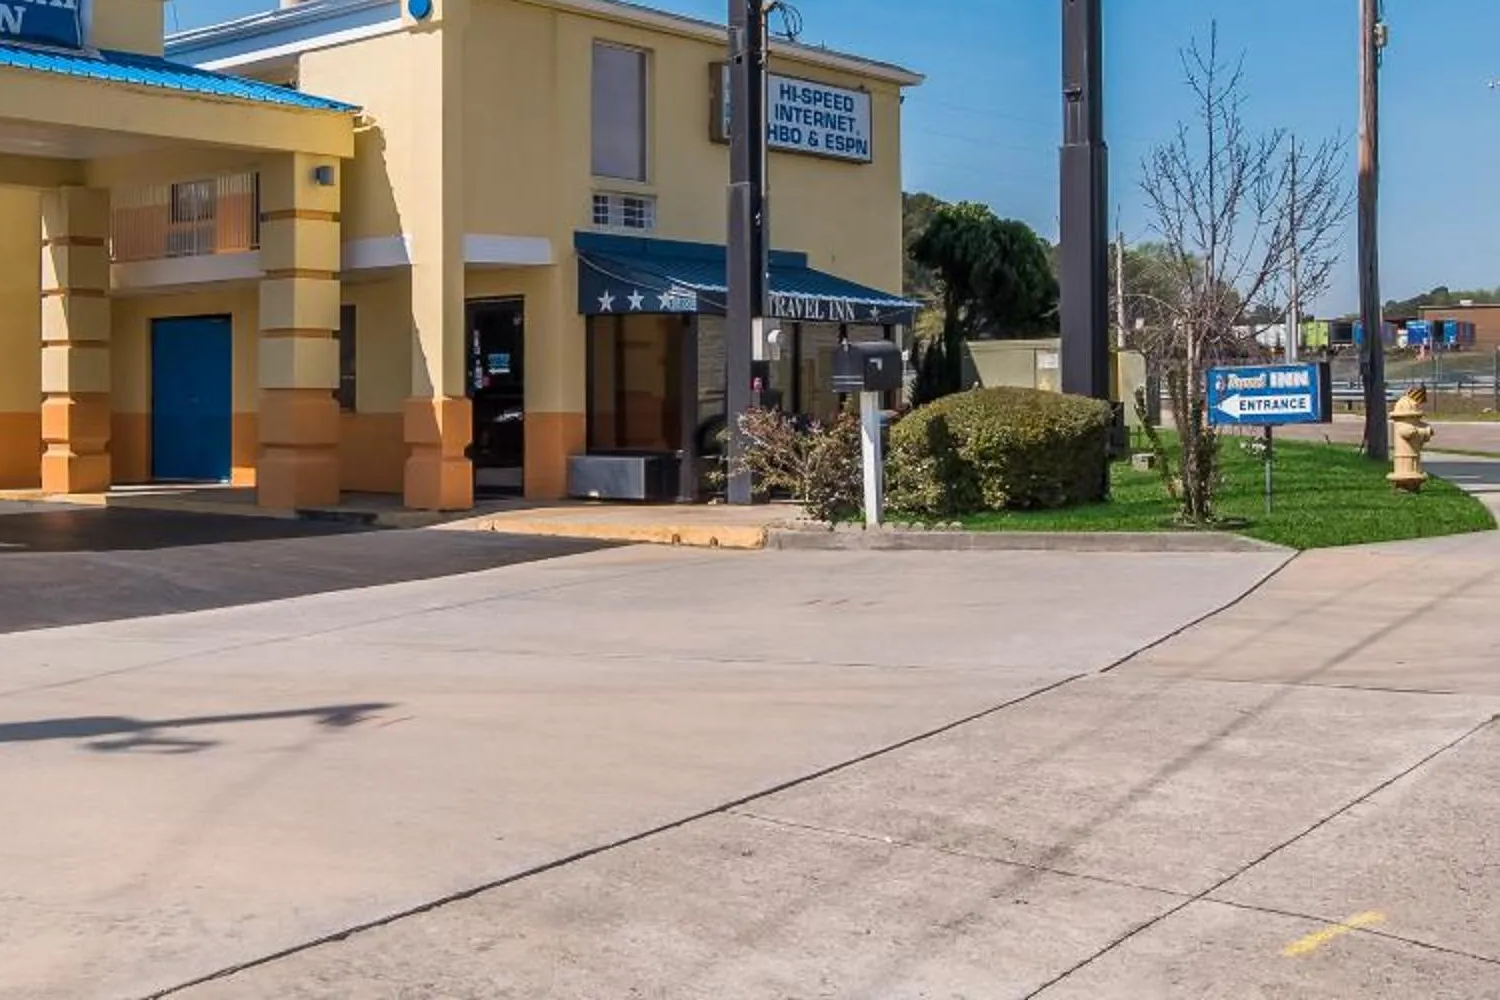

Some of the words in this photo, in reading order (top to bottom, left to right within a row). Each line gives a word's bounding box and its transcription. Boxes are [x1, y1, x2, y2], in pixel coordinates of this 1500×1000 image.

[779, 83, 854, 112] HI-SPEED
[767, 122, 801, 144] HBO
[808, 130, 819, 147] &
[825, 133, 867, 155] ESPN
[829, 299, 856, 321] INN
[1239, 397, 1307, 411] ENTRANCE
